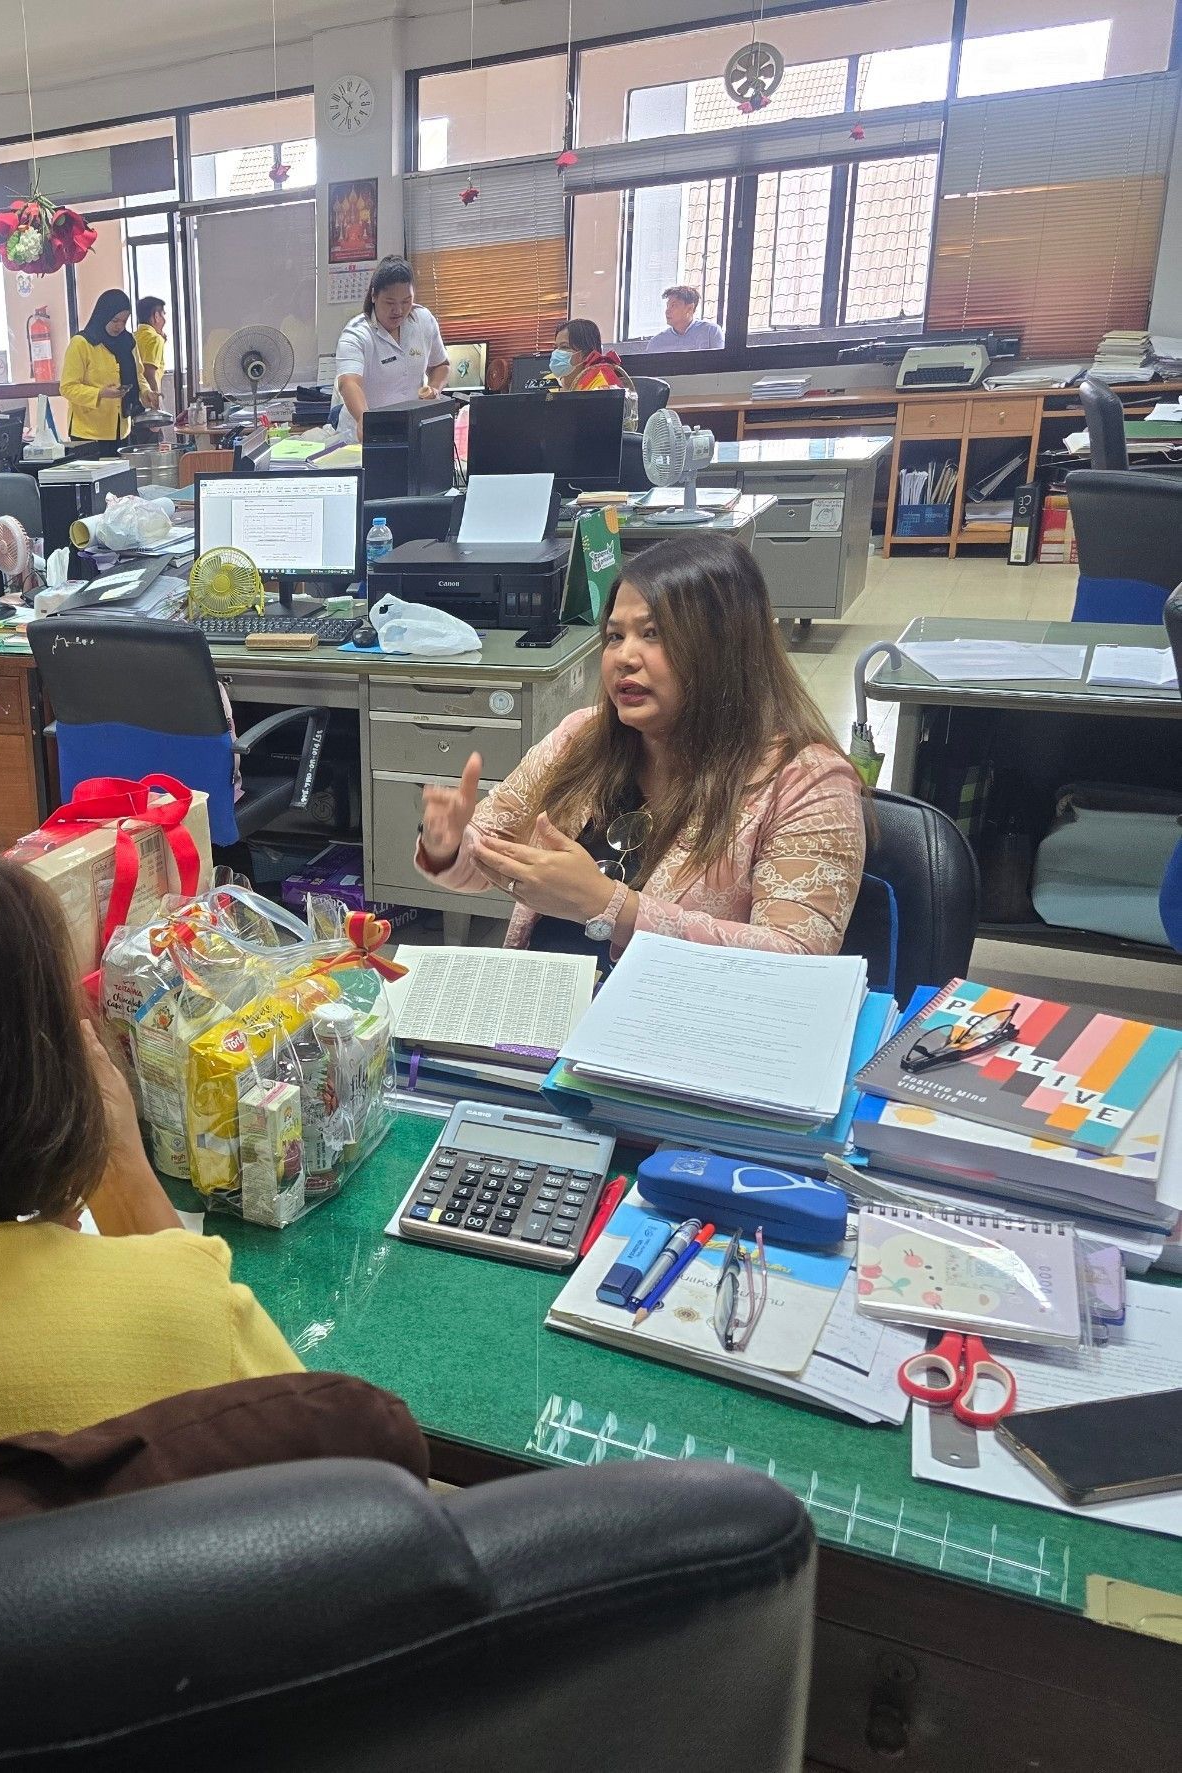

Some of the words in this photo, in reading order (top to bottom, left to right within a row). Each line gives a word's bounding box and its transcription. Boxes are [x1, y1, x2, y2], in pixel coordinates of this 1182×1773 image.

[946, 999, 1121, 1122] POITIVE
[955, 1087, 988, 1103] Mind
[465, 1109, 492, 1118] CASIO
[438, 1156, 456, 1165] TAX+
[491, 1166, 508, 1175] M+
[545, 1176, 562, 1186] MR
[570, 1180, 587, 1190] MC
[432, 1169, 449, 1178] AC
[465, 1175, 475, 1183] 7
[488, 1179, 498, 1188] 8
[513, 1183, 524, 1193] 9
[566, 1194, 581, 1203] GT
[457, 1187, 468, 1196] 4
[483, 1191, 493, 1200] 5
[507, 1196, 517, 1206] 6
[445, 1212, 456, 1221] 0
[467, 1217, 483, 1227] 00
[476, 1205, 488, 1214] 2
[501, 1209, 511, 1218] 3
